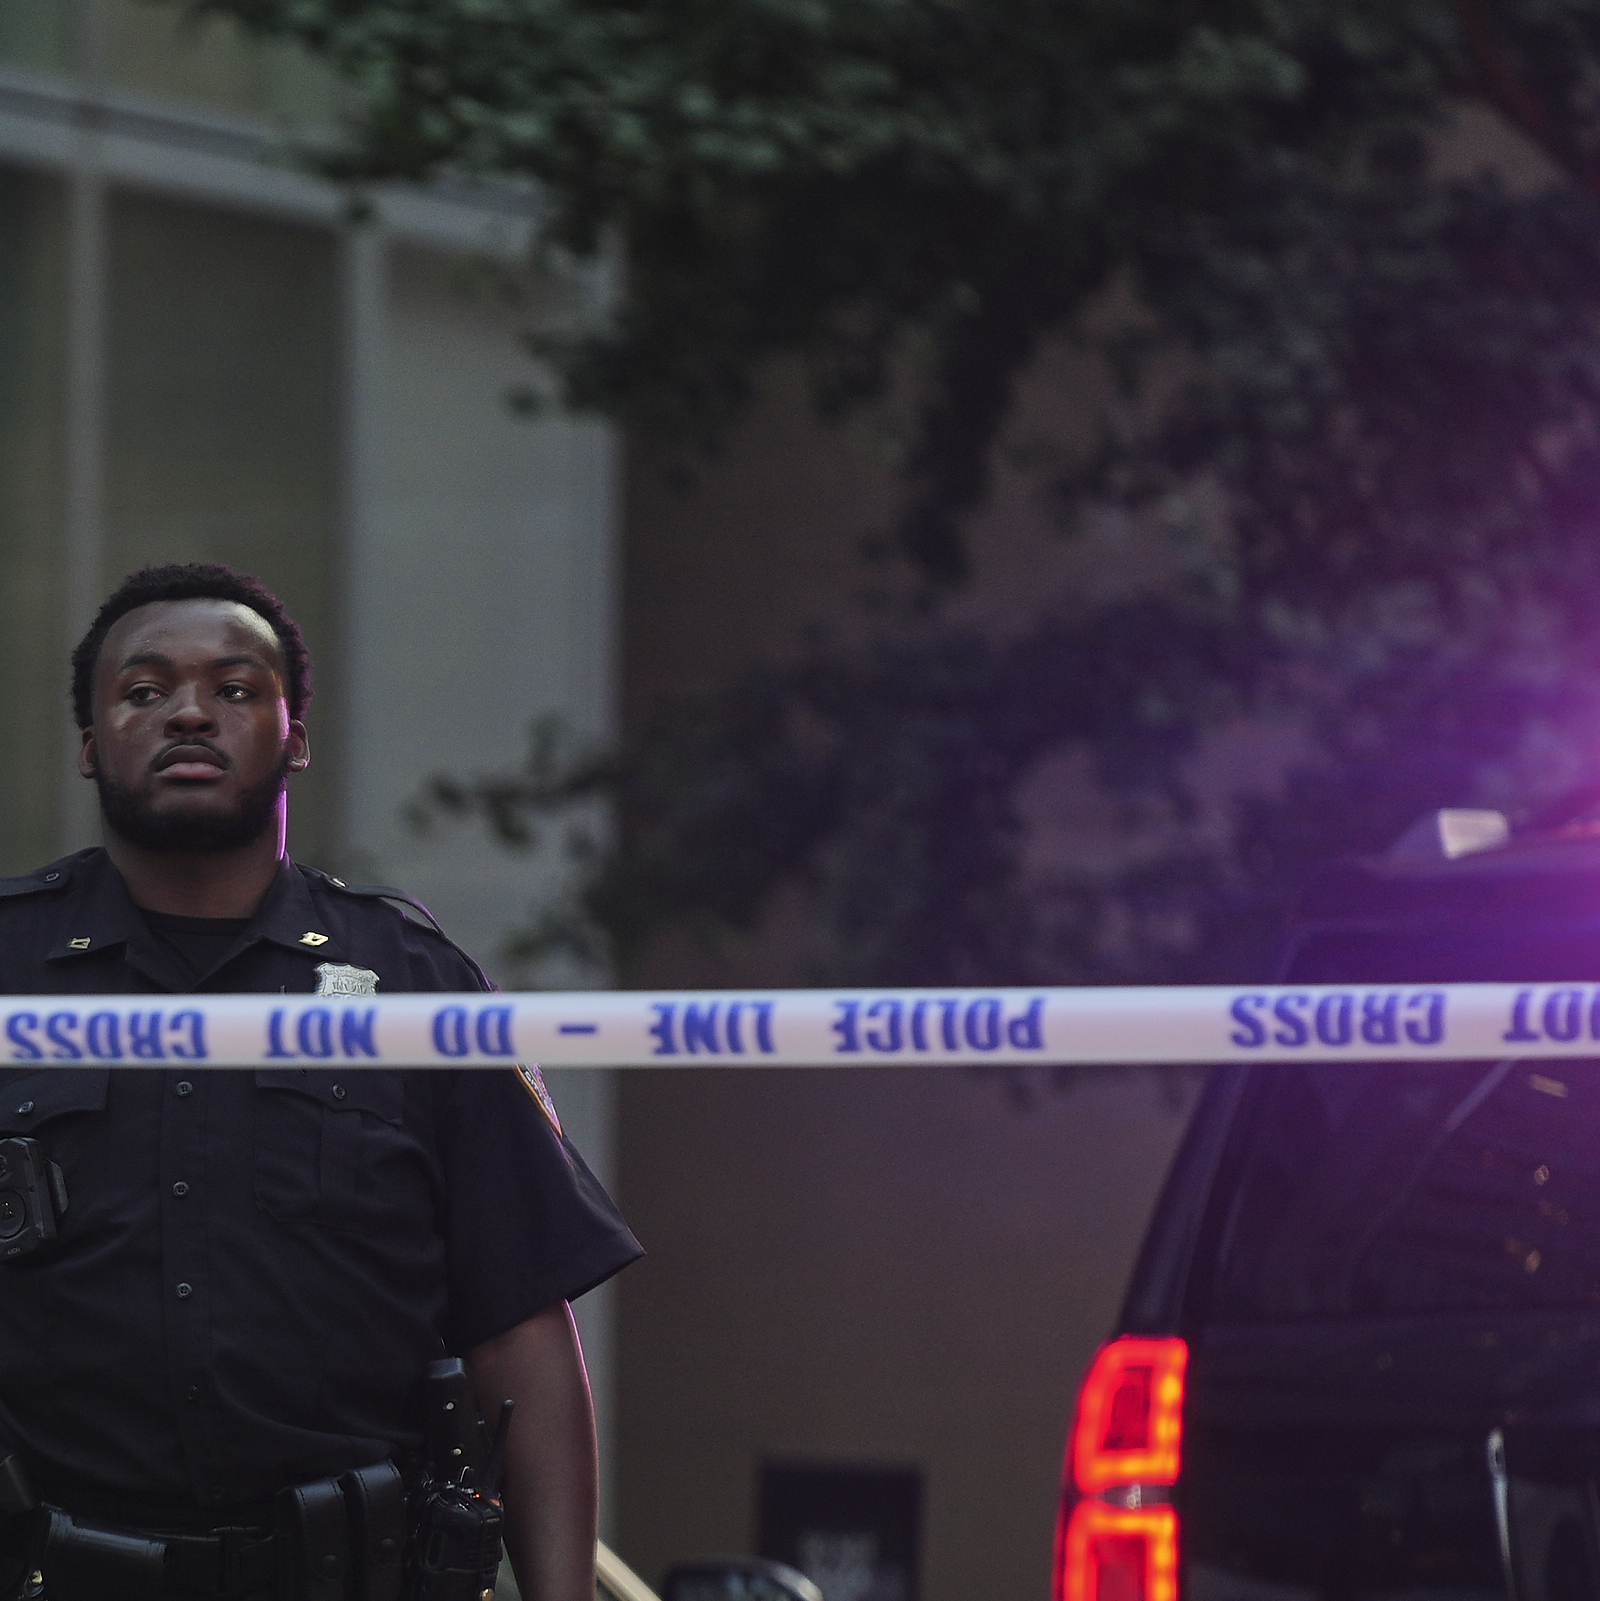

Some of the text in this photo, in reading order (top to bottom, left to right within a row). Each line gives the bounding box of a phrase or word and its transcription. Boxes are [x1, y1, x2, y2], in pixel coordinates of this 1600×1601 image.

[4, 1009, 208, 1062] CROSS
[264, 1005, 380, 1060] NOT
[432, 1004, 518, 1058] DO
[650, 1000, 778, 1055] LINE
[832, 997, 1047, 1053] POLICE
[1230, 990, 1448, 1049] CROSS
